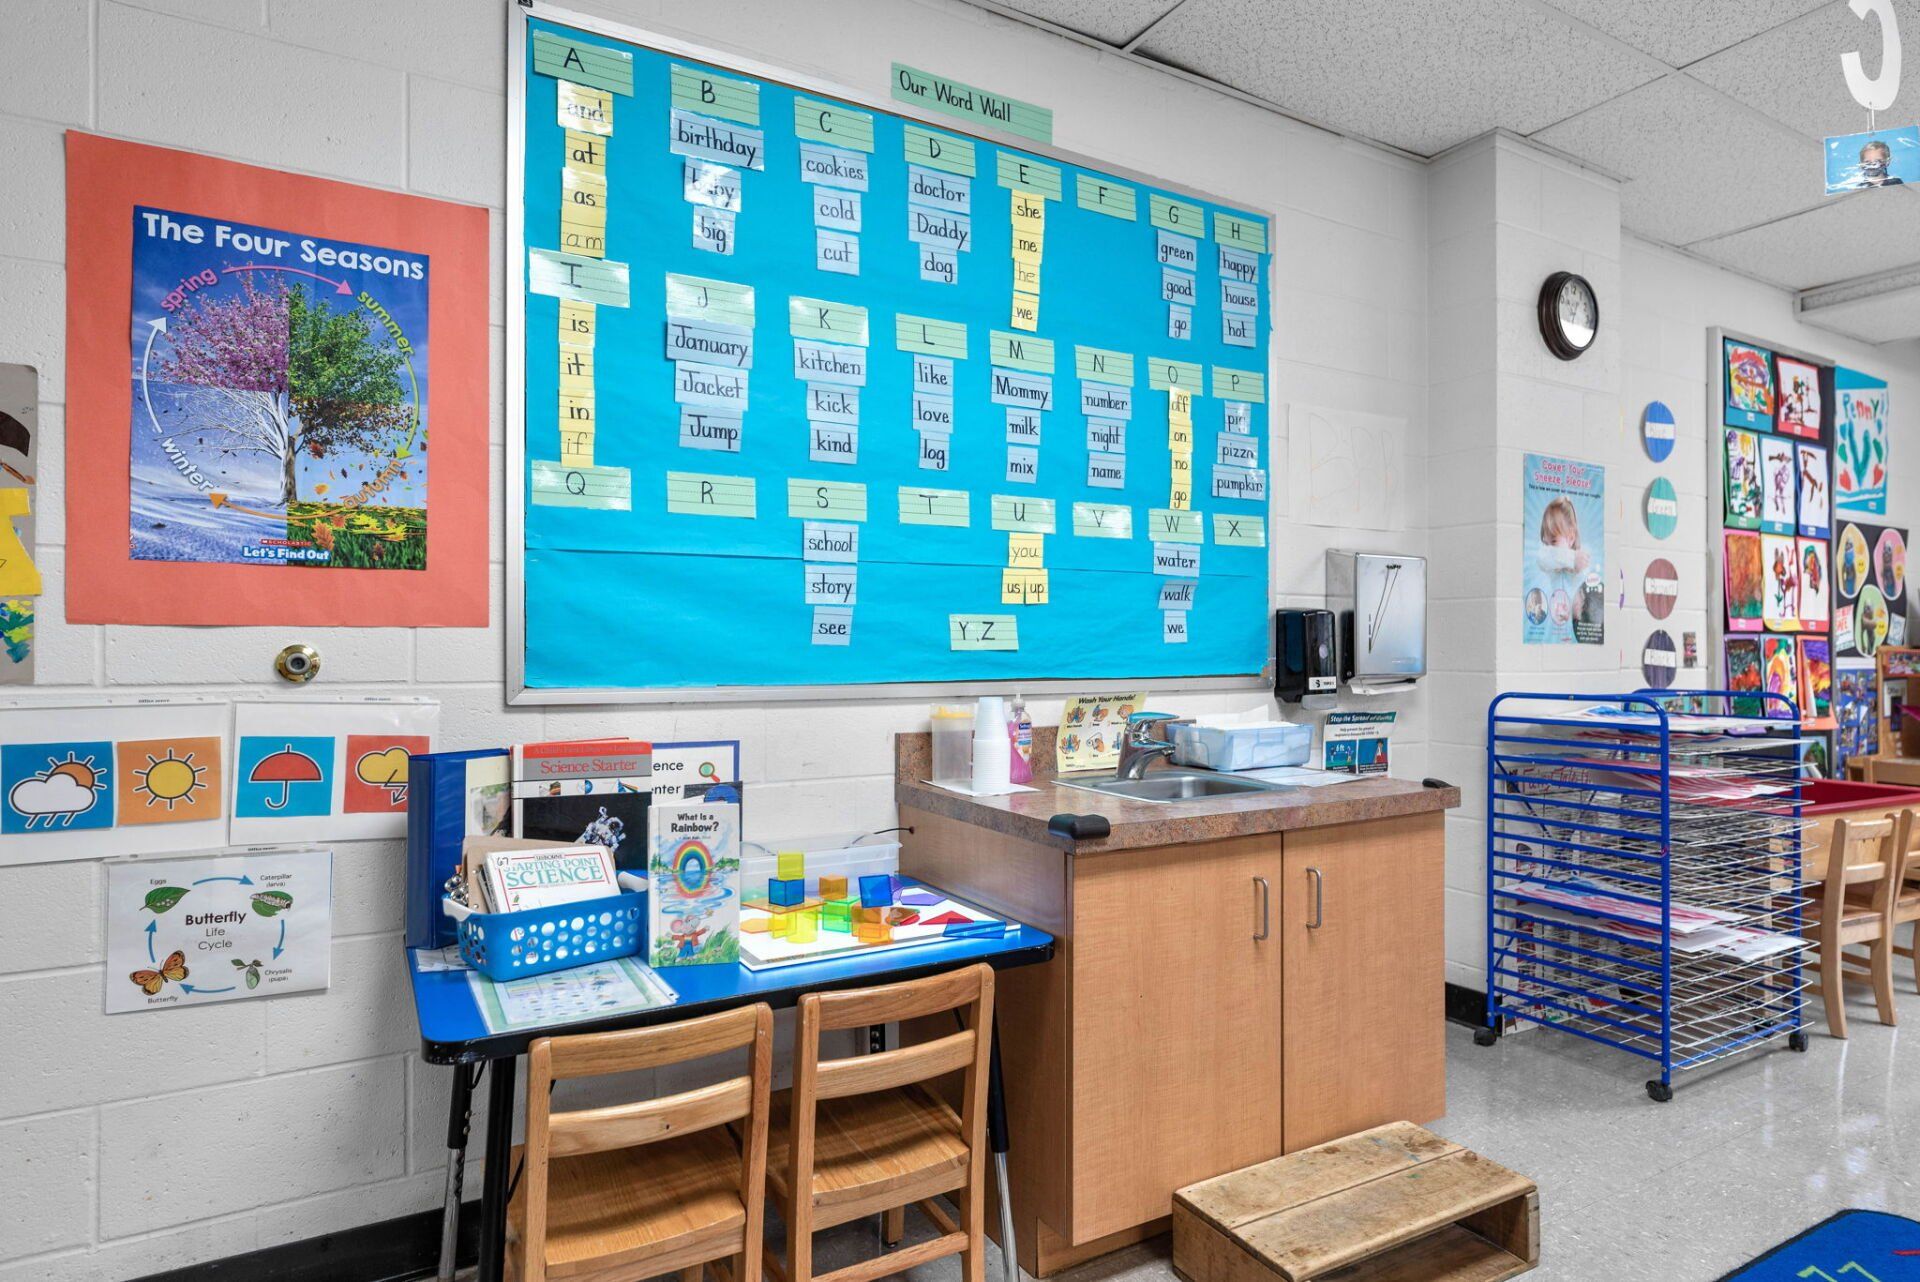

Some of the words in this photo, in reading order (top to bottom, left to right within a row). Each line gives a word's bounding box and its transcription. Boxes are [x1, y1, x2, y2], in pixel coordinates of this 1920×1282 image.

[563, 47, 585, 73] A
[701, 80, 715, 104] B
[900, 70, 927, 97] Our
[935, 81, 973, 112] Word
[981, 98, 1011, 123] Wall
[567, 98, 605, 123] and
[819, 111, 832, 134] C
[573, 142, 598, 164] at
[677, 124, 756, 168] birthday
[930, 138, 941, 158] D
[806, 153, 865, 181] cookies
[1019, 164, 1030, 184] E
[692, 167, 735, 208] bby
[913, 174, 966, 202] doctor
[1099, 187, 1108, 204] F
[574, 190, 596, 207] as
[820, 200, 856, 221] cold
[1016, 199, 1041, 219] she
[1168, 206, 1179, 224] G
[701, 216, 726, 253] big
[917, 212, 968, 250] Daddy
[1231, 222, 1241, 239] H
[143, 212, 205, 244] The
[215, 225, 291, 258] Four
[300, 238, 424, 281] Seasons
[823, 243, 853, 263] cut
[1018, 237, 1038, 253] me
[1160, 242, 1194, 263] green
[560, 262, 583, 288] I
[924, 253, 953, 282] dog
[1017, 262, 1036, 283] he
[1223, 251, 1256, 283] happy
[160, 267, 220, 313] spring
[697, 286, 709, 308] J
[1166, 279, 1193, 299] good
[1224, 285, 1256, 307] house
[356, 290, 415, 357] summer
[572, 313, 590, 334] is
[818, 308, 830, 330] K
[1016, 306, 1033, 322] we
[922, 323, 935, 345] L
[1173, 318, 1187, 333] go
[1227, 319, 1247, 337] hot
[673, 324, 749, 367] January
[1009, 340, 1024, 360] M
[567, 353, 585, 377] it
[799, 346, 862, 376] kitchen
[1093, 354, 1104, 373] N
[918, 359, 949, 386] like
[1231, 374, 1240, 391] P
[679, 369, 744, 399] Jacket
[995, 375, 1049, 409] Mommy
[570, 399, 590, 421] in
[815, 388, 854, 415] kick
[1084, 393, 1127, 411] number
[1171, 394, 1189, 413] off
[917, 400, 950, 425] love
[687, 413, 739, 450] Jump
[1008, 417, 1039, 437] milk
[1173, 431, 1187, 443] on
[566, 432, 588, 456] if
[816, 429, 853, 455] kind
[1091, 430, 1121, 452] night
[923, 440, 946, 469] log
[1222, 443, 1255, 463] pizza
[161, 437, 215, 491] winter
[1010, 458, 1034, 476] mix
[1091, 465, 1122, 480] name
[1174, 459, 1189, 470] no
[1542, 459, 1566, 473] Cover
[1568, 464, 1585, 475] Your
[343, 459, 402, 509] autumn
[565, 471, 586, 496] Q
[701, 480, 714, 504] R
[1216, 474, 1264, 498] pumpkin
[816, 487, 829, 509] S
[919, 494, 939, 515] T
[1173, 491, 1187, 509] go
[1013, 502, 1026, 522] U
[1093, 509, 1105, 528] V
[1165, 515, 1180, 533] W
[1228, 520, 1242, 537] X
[808, 529, 853, 553] school
[243, 546, 275, 558] Let's
[277, 548, 305, 560] Find
[306, 549, 330, 560] Out
[1011, 544, 1040, 562] you
[1156, 553, 1196, 569] water
[811, 575, 853, 604] story
[1006, 581, 1021, 595] us
[1029, 580, 1045, 600] up
[1163, 586, 1191, 602] walk
[818, 621, 847, 636] see
[1166, 622, 1184, 635] we
[1078, 697, 1097, 705] Wash
[1330, 714, 1342, 722] Stop
[1351, 714, 1370, 722] Spread
[540, 760, 590, 774] Science
[592, 758, 638, 773] Starter
[652, 784, 681, 794] nter
[677, 812, 698, 821] What
[670, 821, 720, 833] Rainbow?
[496, 856, 509, 867] 67
[563, 857, 598, 868] POINT
[149, 878, 167, 886] Eggs
[260, 873, 293, 881] Caterpillar
[505, 866, 604, 888] SCIENCE
[185, 910, 247, 926] Butterfly
[205, 927, 226, 937] Life
[198, 940, 233, 951] Cycle
[264, 967, 293, 976] Chrysalis
